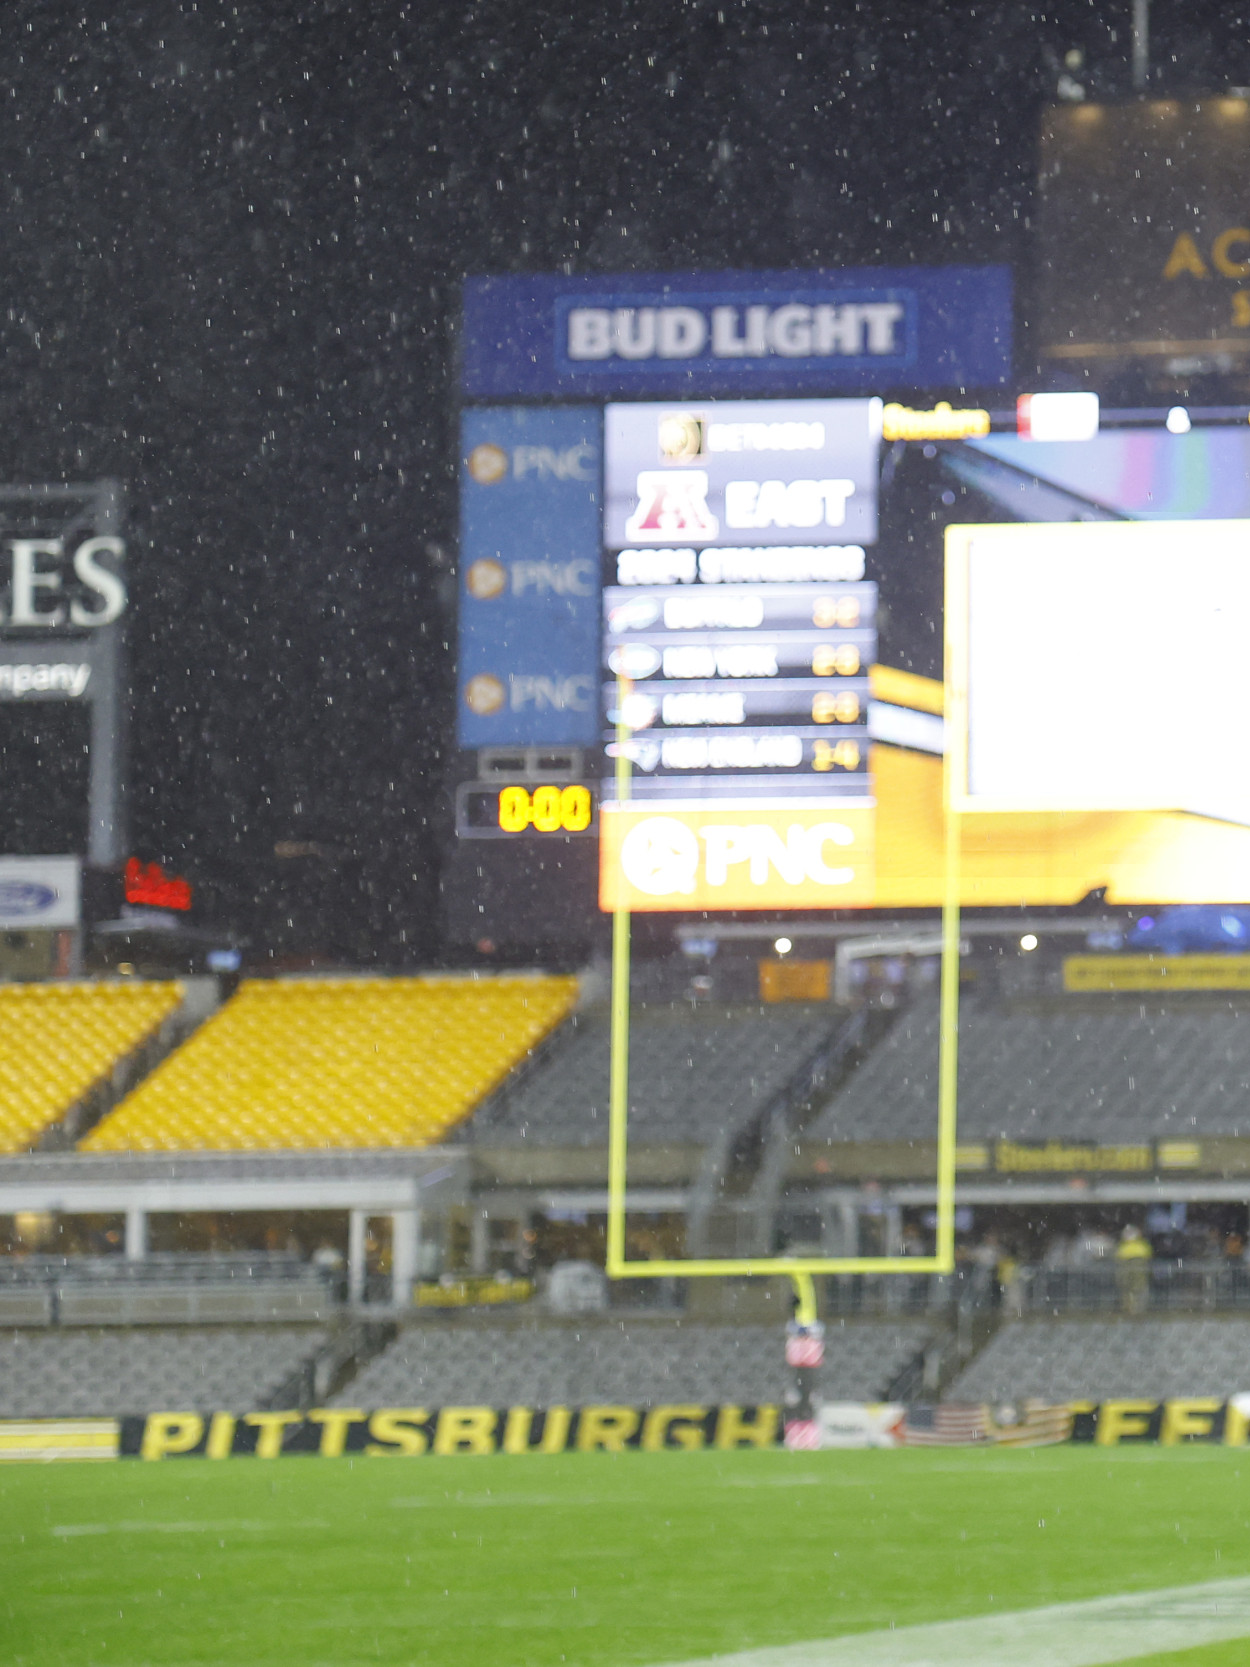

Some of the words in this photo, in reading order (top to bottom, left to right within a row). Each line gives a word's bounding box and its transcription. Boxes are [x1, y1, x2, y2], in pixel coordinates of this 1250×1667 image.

[567, 307, 708, 361] BUD
[711, 302, 904, 357] LIGHT
[512, 445, 597, 481] PNC
[724, 478, 856, 529] EAST
[0, 535, 127, 628] ES
[510, 559, 597, 597] PNC
[509, 673, 596, 712] PNC
[699, 821, 855, 886] PNC
[140, 1404, 780, 1461] PITTSBURGH
